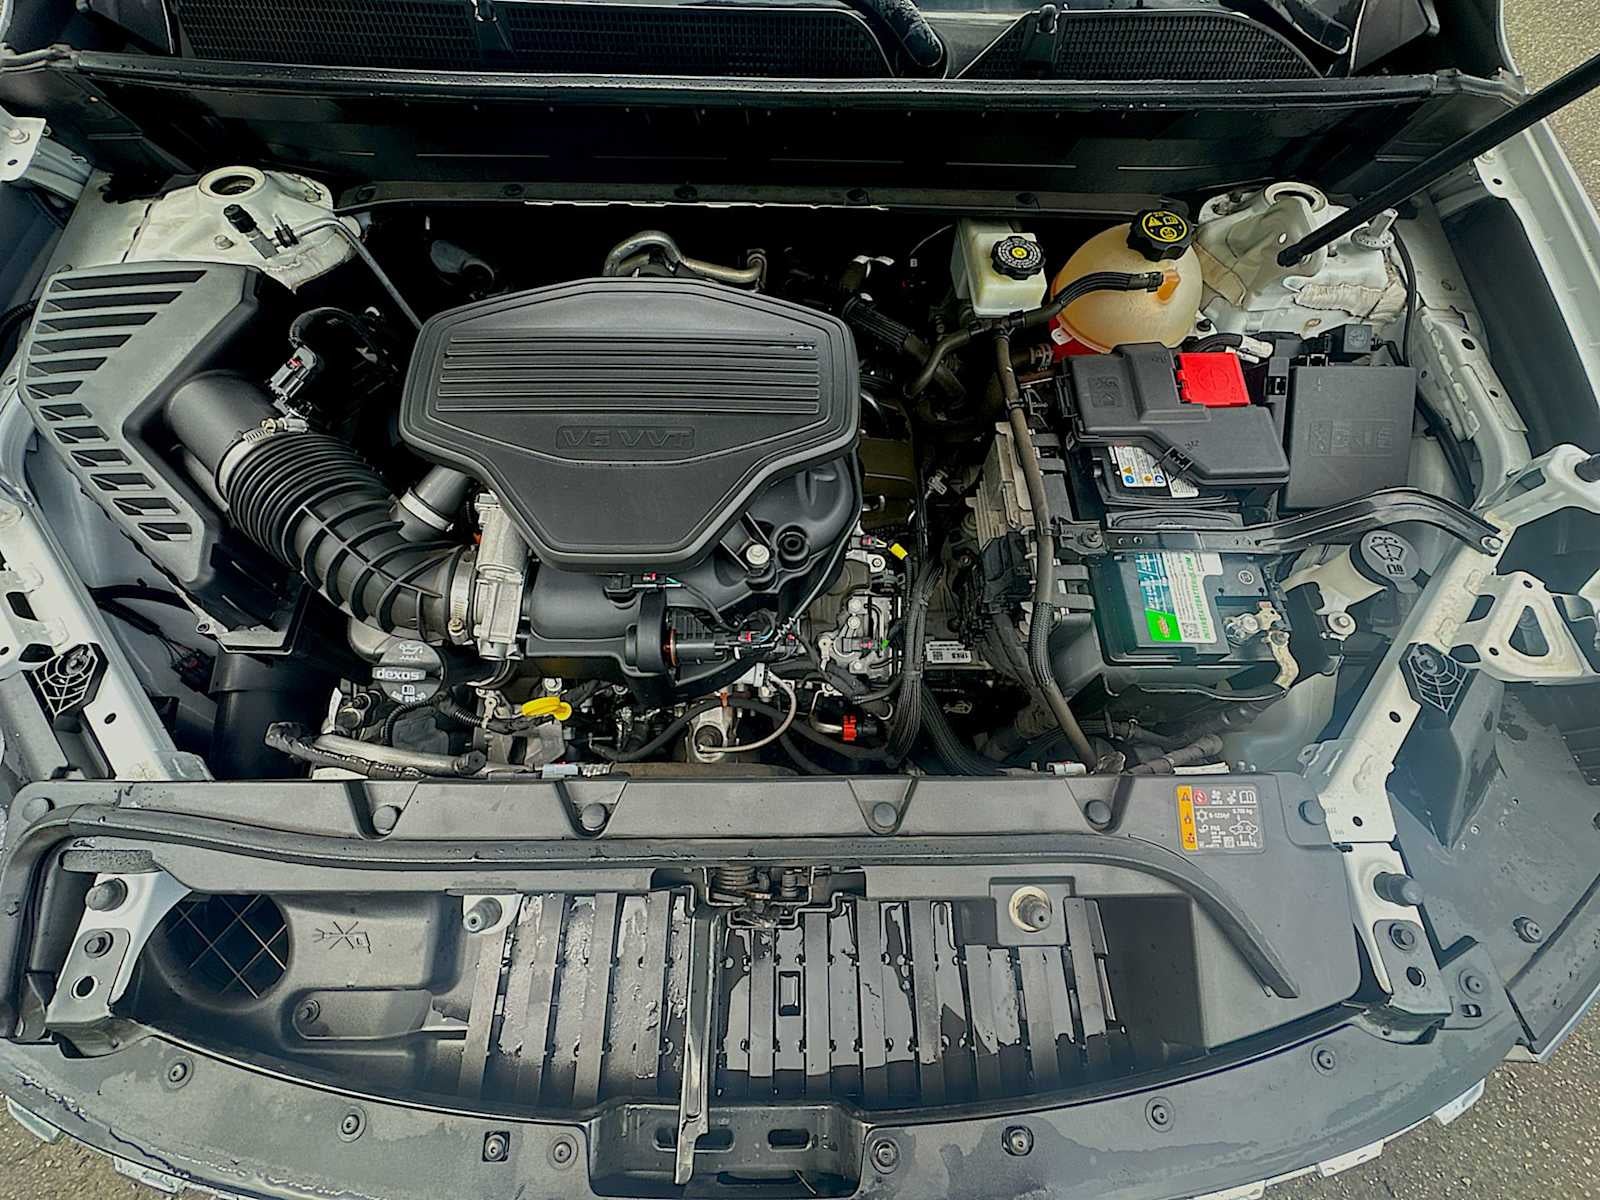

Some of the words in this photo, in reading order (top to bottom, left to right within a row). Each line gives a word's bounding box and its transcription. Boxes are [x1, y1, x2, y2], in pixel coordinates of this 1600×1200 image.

[562, 429, 610, 447] V6
[617, 429, 690, 447] VVT
[376, 668, 420, 680] dexos
